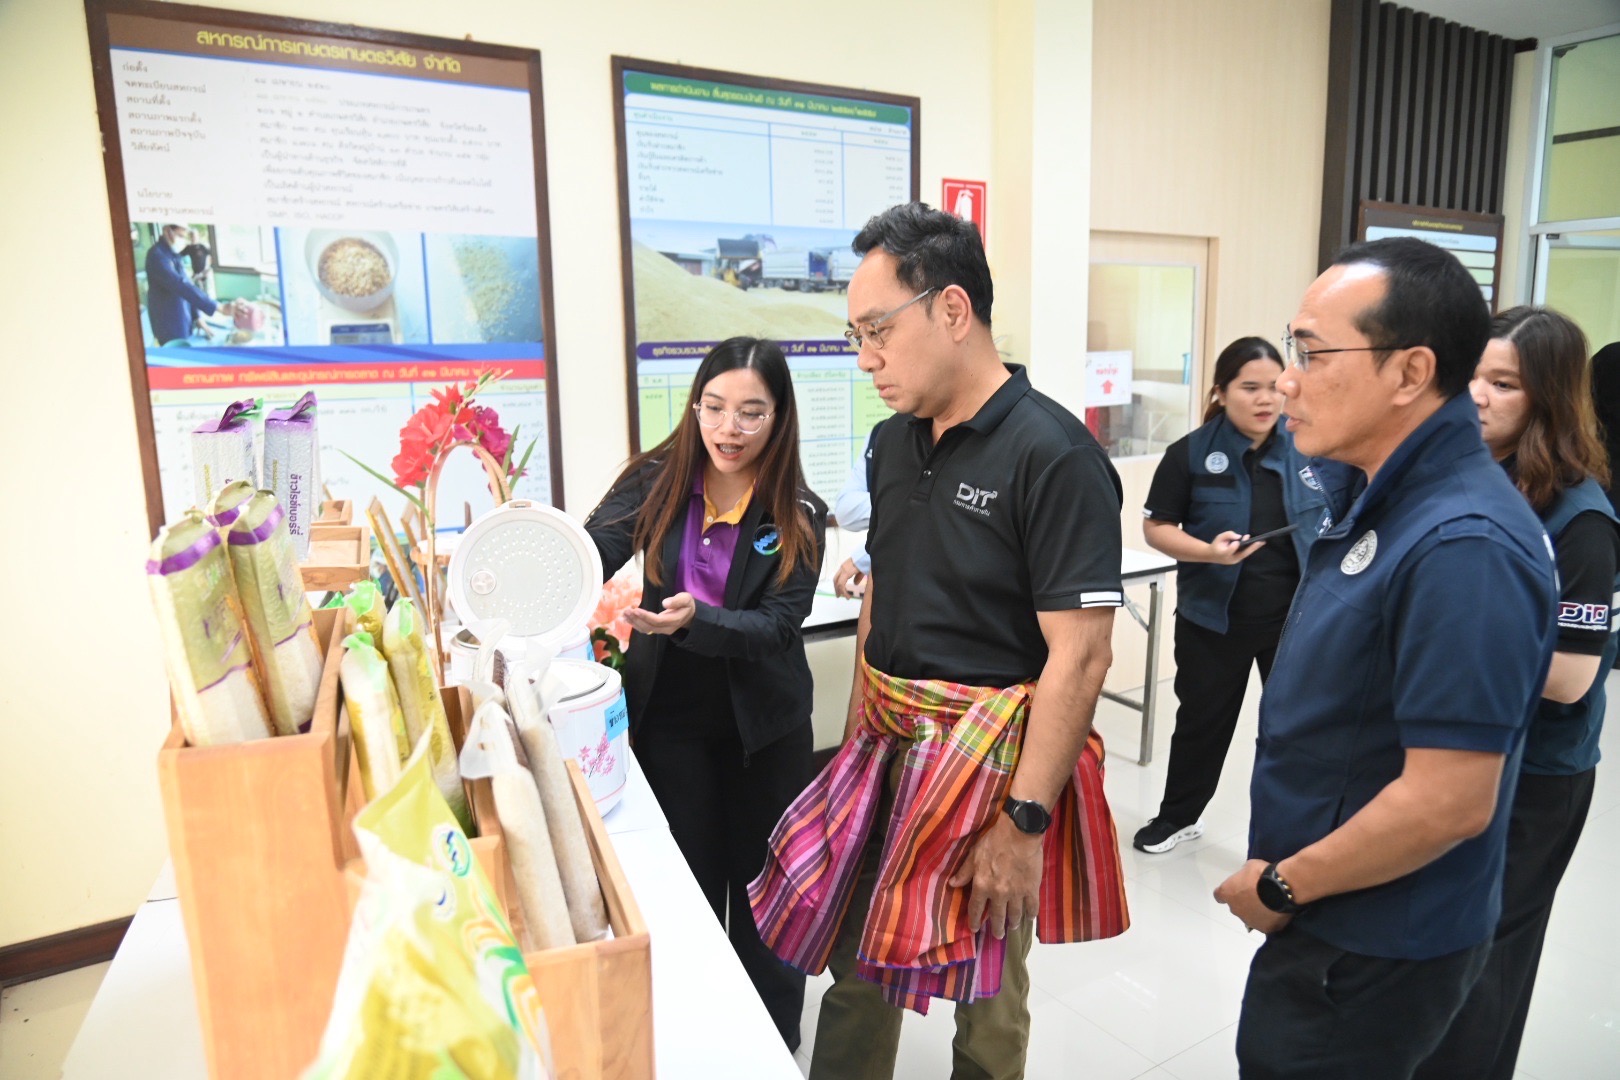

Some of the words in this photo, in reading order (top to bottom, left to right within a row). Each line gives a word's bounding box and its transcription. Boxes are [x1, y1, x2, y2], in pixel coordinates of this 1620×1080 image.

[197, 29, 416, 68] สหกรณ์การเกษตรเกษตรวิสัย
[424, 55, 461, 74] จำกัด
[183, 371, 235, 384] สถานภาพ
